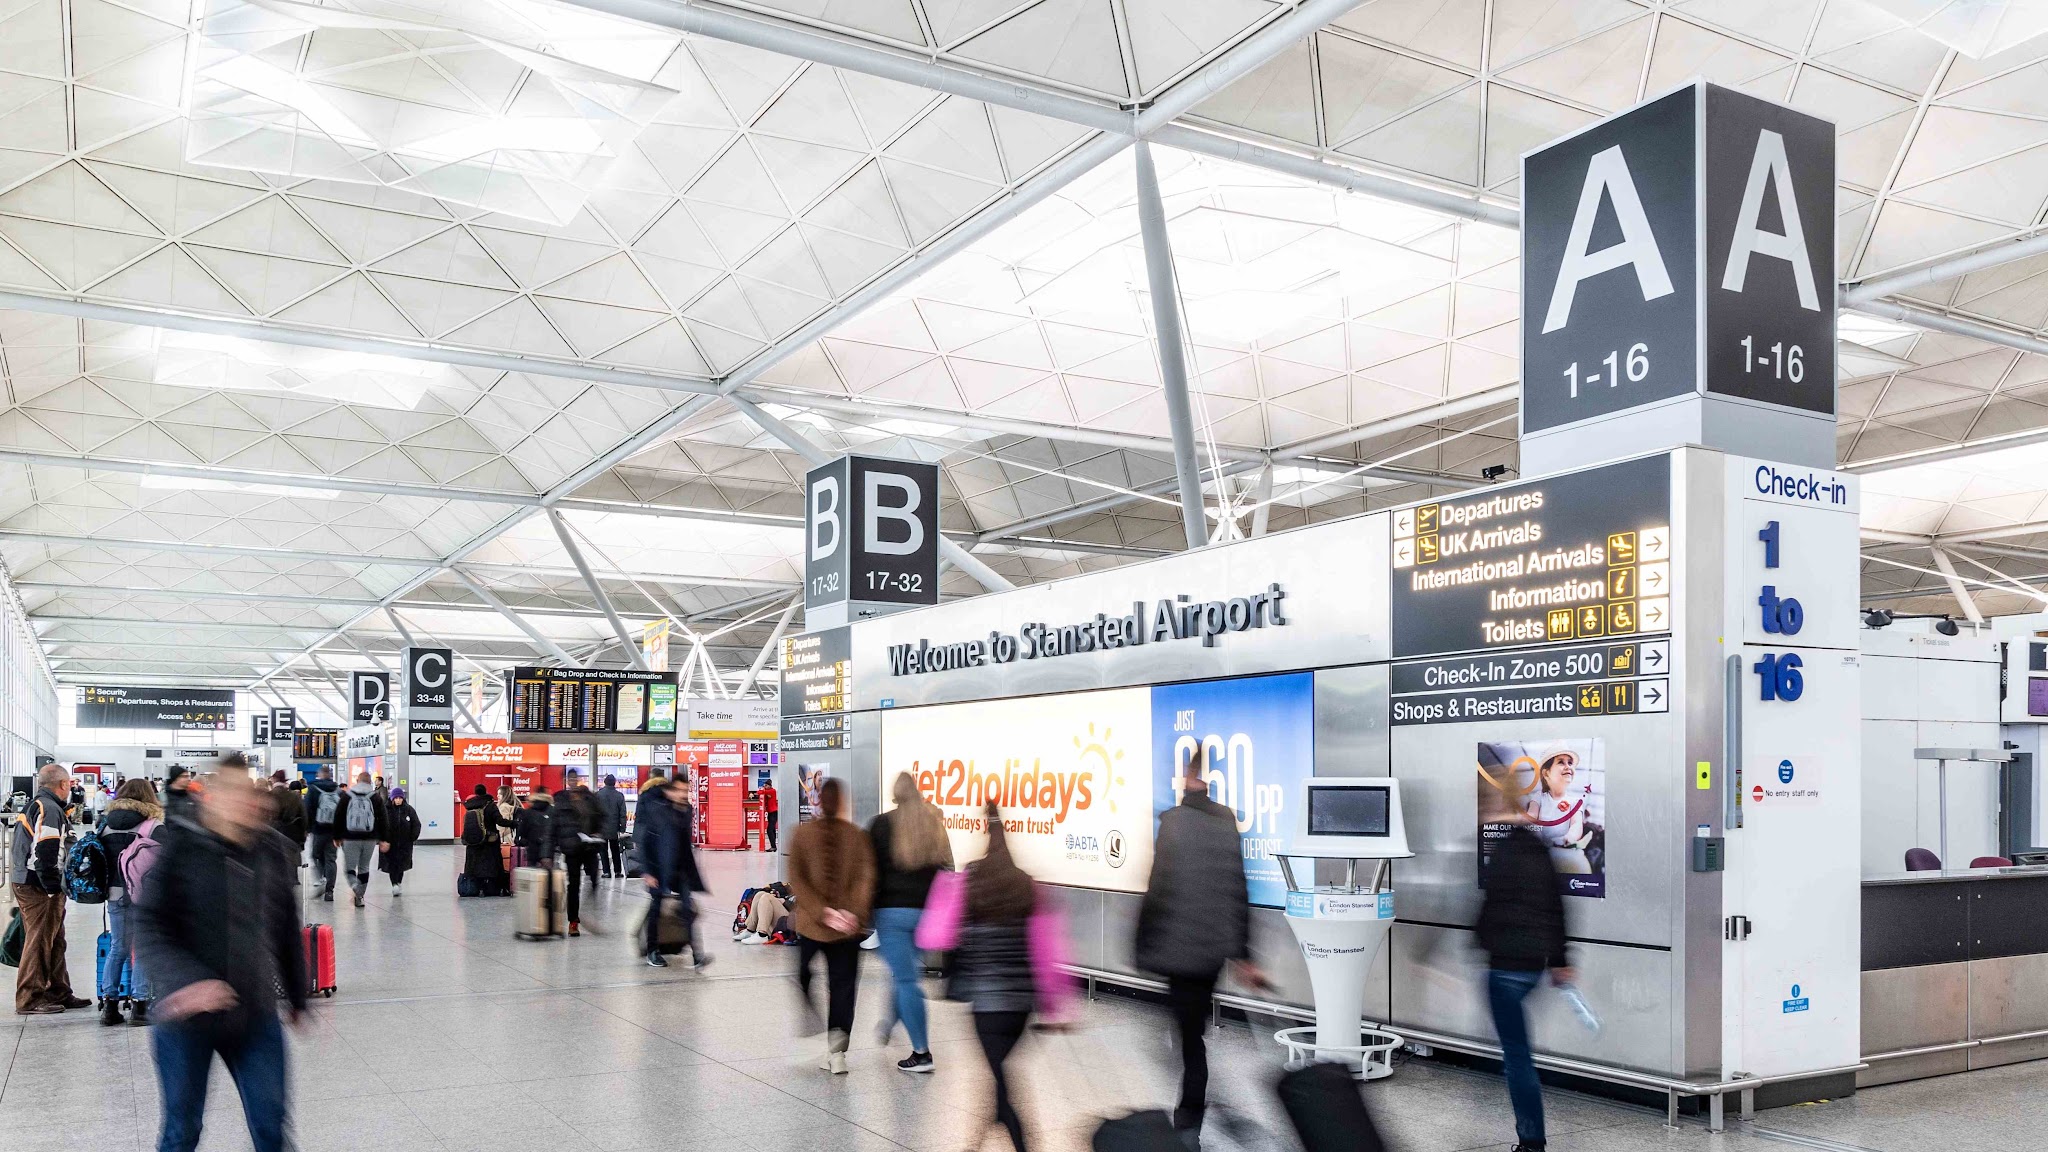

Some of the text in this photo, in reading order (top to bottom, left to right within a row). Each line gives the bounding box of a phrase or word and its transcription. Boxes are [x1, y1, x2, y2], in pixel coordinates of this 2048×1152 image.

[1722, 128, 1821, 312] A
[1542, 144, 1675, 334] A
[1563, 343, 1649, 398] 1-16
[1740, 335, 1804, 383] 1-16
[1756, 466, 1846, 504] Check-in
[812, 476, 840, 562] B
[864, 470, 924, 556] B
[1441, 491, 1543, 526] Departures
[1440, 522, 1542, 556] UK Arrivals
[1759, 520, 1780, 568] 1
[1413, 544, 1604, 590] International Arrivals
[812, 572, 839, 596] 17-32
[866, 571, 922, 592] 17-32
[1491, 580, 1604, 612] Information
[1759, 586, 1804, 636] to
[887, 582, 1286, 676] Welcome to Stansted Airport
[1482, 620, 1544, 643] Toilets
[794, 637, 820, 650] Departures
[416, 653, 446, 688] C
[568, 671, 584, 679] Drop
[1424, 652, 1602, 686] Check-In Zone 500
[1754, 652, 1804, 701] 16
[359, 676, 384, 704] D
[417, 694, 444, 703] 33-48
[806, 684, 835, 695] Information
[276, 710, 291, 729] E
[360, 709, 384, 717] 49-2
[1394, 692, 1573, 723] Shops & Restaurants
[789, 719, 835, 732] Check-In Zone 500
[1174, 710, 1195, 732] JUST
[464, 744, 523, 754] Jet2.com
[563, 747, 629, 759] jet2olidays
[781, 740, 796, 750] Shops
[800, 738, 828, 748] Restaurants
[617, 768, 636, 777] MALTA
[1004, 819, 1024, 832] can
[1027, 816, 1054, 834] trust
[1075, 836, 1098, 850] ABTA
[1244, 838, 1283, 860] DEPOSIT
[1288, 895, 1311, 908] FREE
